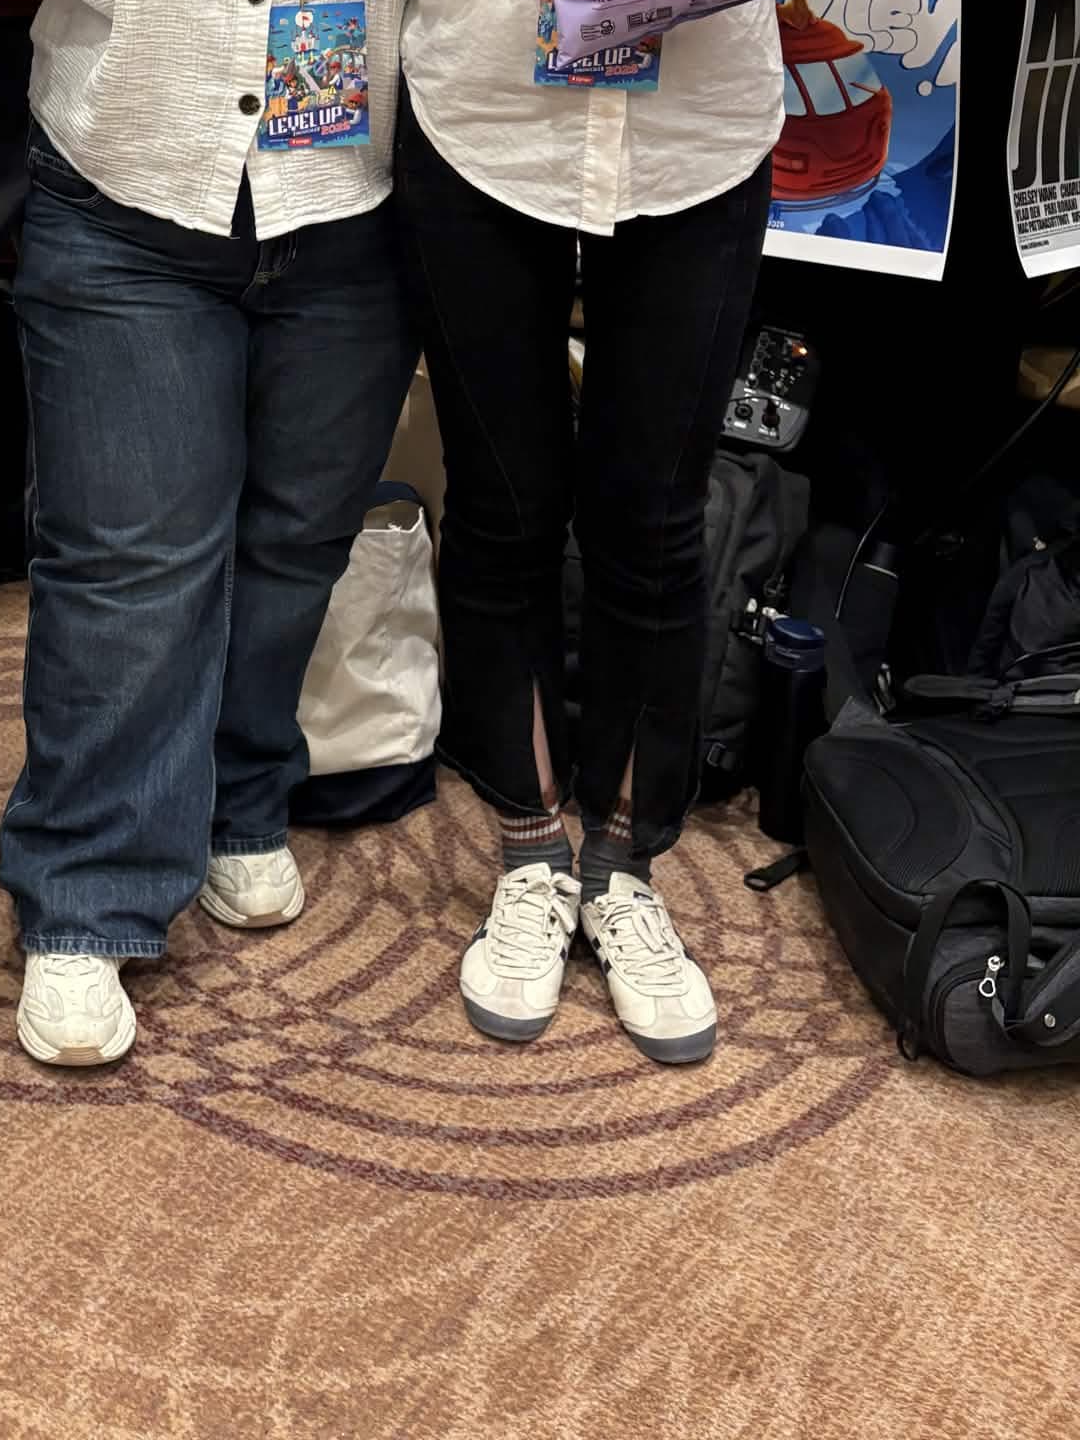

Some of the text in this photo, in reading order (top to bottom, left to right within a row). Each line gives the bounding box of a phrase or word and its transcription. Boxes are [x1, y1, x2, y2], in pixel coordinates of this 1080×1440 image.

[604, 47, 631, 66] UP
[269, 111, 318, 136] LEVEL
[319, 106, 343, 126] UP
